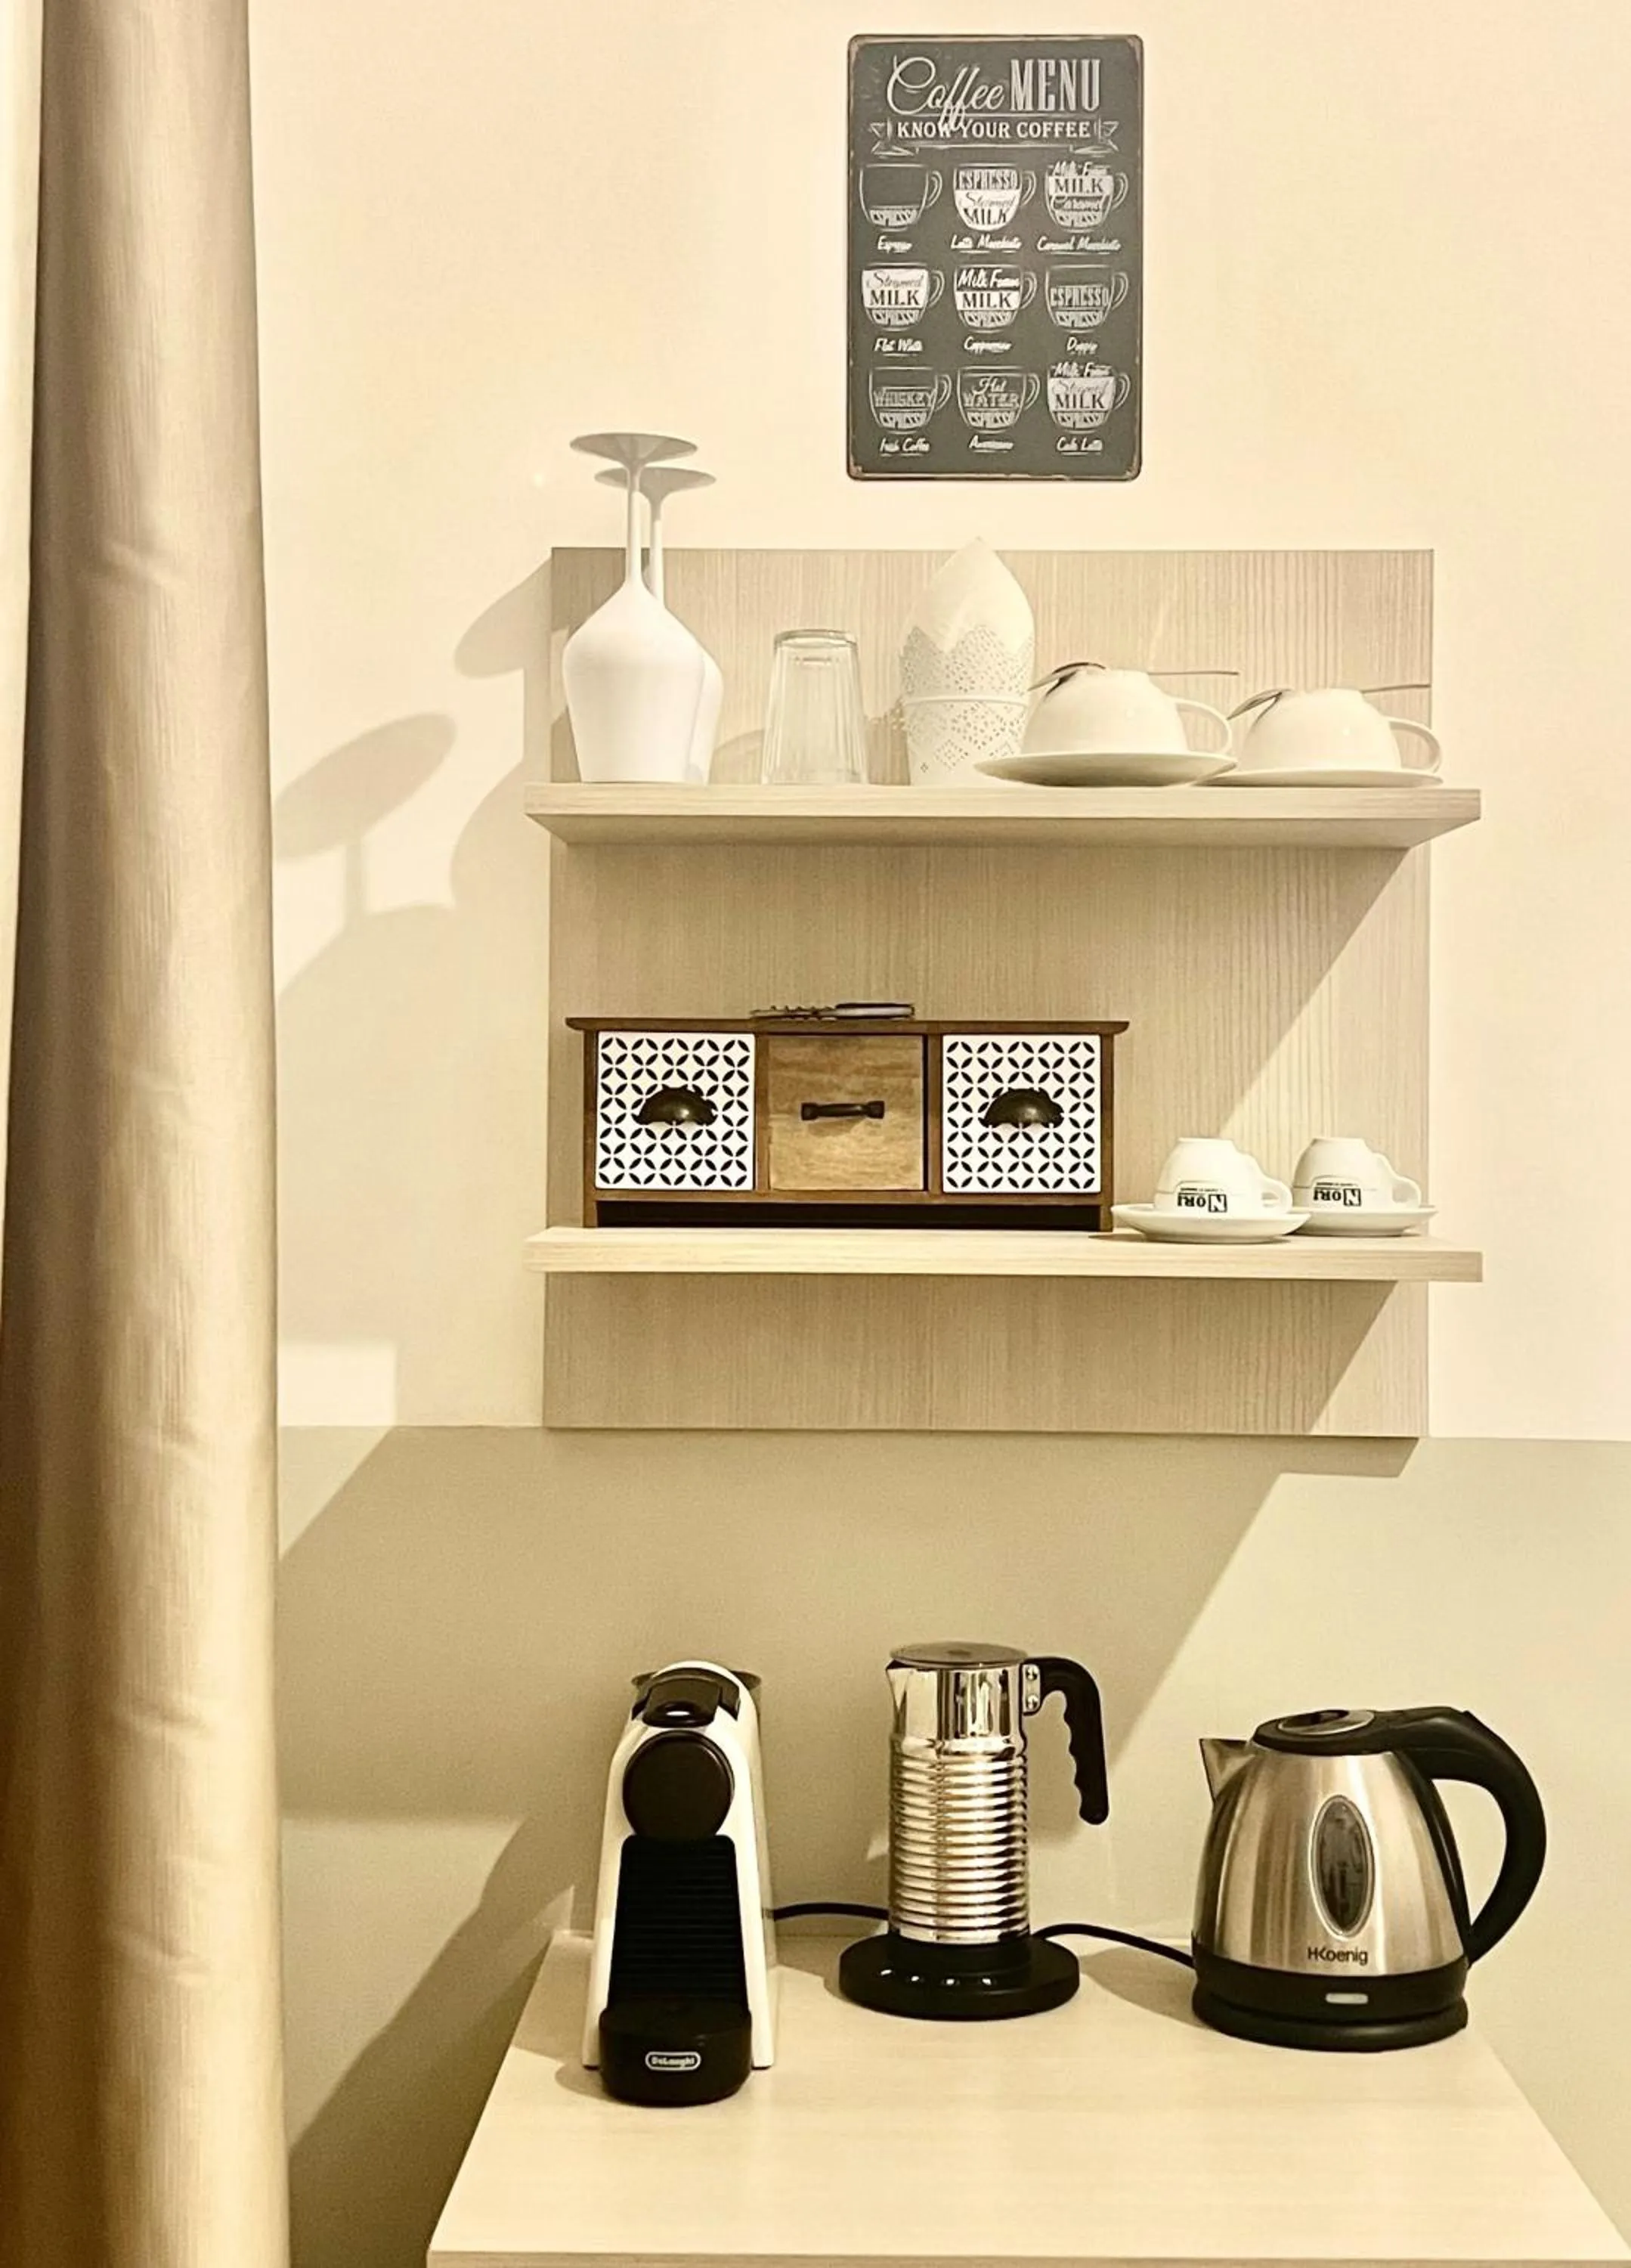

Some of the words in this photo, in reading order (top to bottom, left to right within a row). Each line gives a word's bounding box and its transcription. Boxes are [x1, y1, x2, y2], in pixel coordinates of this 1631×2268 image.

[887, 55, 1004, 131] Coffee
[1010, 59, 1100, 111] MENU
[898, 121, 951, 138] KNOW
[960, 119, 1010, 138] YOUR
[1017, 121, 1091, 138] COFFEE
[958, 169, 1018, 189] ESPRESSO
[1055, 177, 1103, 193] MILK
[963, 208, 1010, 225] MILK
[870, 290, 921, 305] MILK
[962, 293, 1012, 308] MILK
[1050, 287, 1110, 306] ESPRESSO
[962, 392, 1020, 407] WATER
[1055, 393, 1106, 409] MILK
